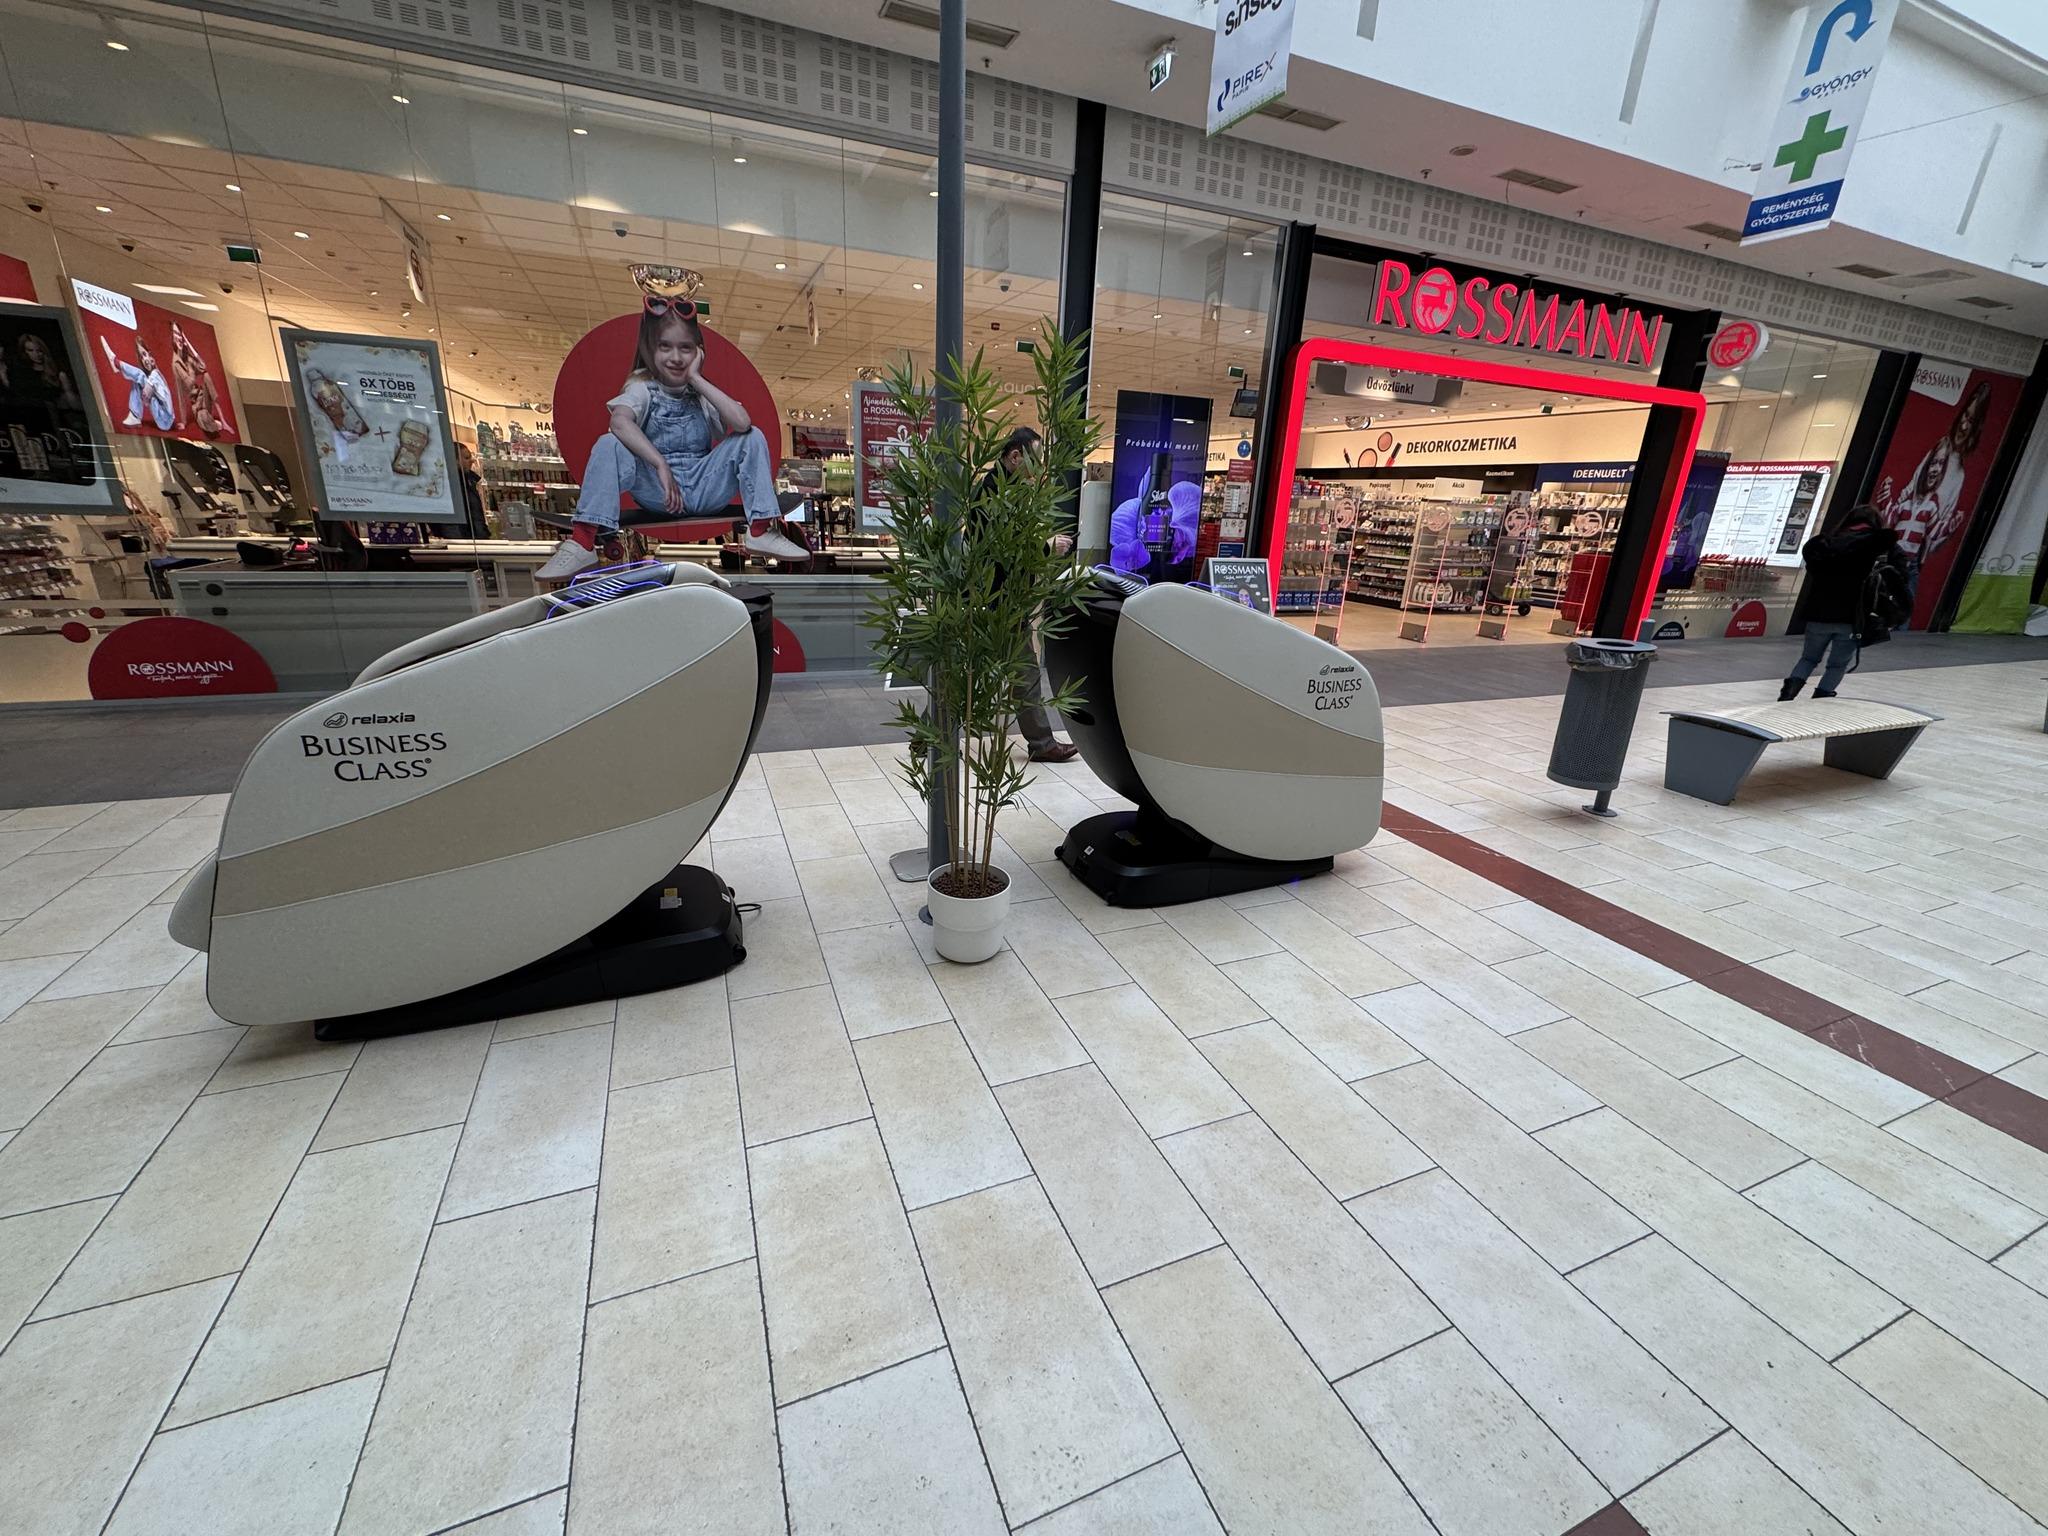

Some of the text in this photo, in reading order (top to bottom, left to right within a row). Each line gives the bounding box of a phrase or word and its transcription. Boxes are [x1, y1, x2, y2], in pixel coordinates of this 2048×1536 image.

[1232, 51, 1277, 94] PIREX
[1811, 65, 1874, 96] GYÖNGY
[1761, 192, 1825, 215] REMÉNYSÉG
[1750, 203, 1830, 228] GYÓGYSZERTÁR
[76, 287, 131, 315] ROSSMANN
[1374, 259, 1665, 368] ROSSMANN
[360, 377, 416, 392] 6X TÖBB
[1366, 376, 1414, 396] Üdvözlünk!
[1915, 368, 1964, 390] ROSSMANN
[1126, 438, 1199, 451] Próbáld ki most!
[1406, 436, 1518, 454] DEKORKOZMETIKA
[1572, 468, 1628, 478] IDEENWELT
[1214, 564, 1266, 575] ROSSMANN
[127, 660, 234, 676] ROSSMANN
[1330, 664, 1355, 674] relaxia
[1307, 678, 1362, 694] BUSINESS
[351, 712, 416, 725] relaxia
[300, 732, 448, 757] BUSINESS
